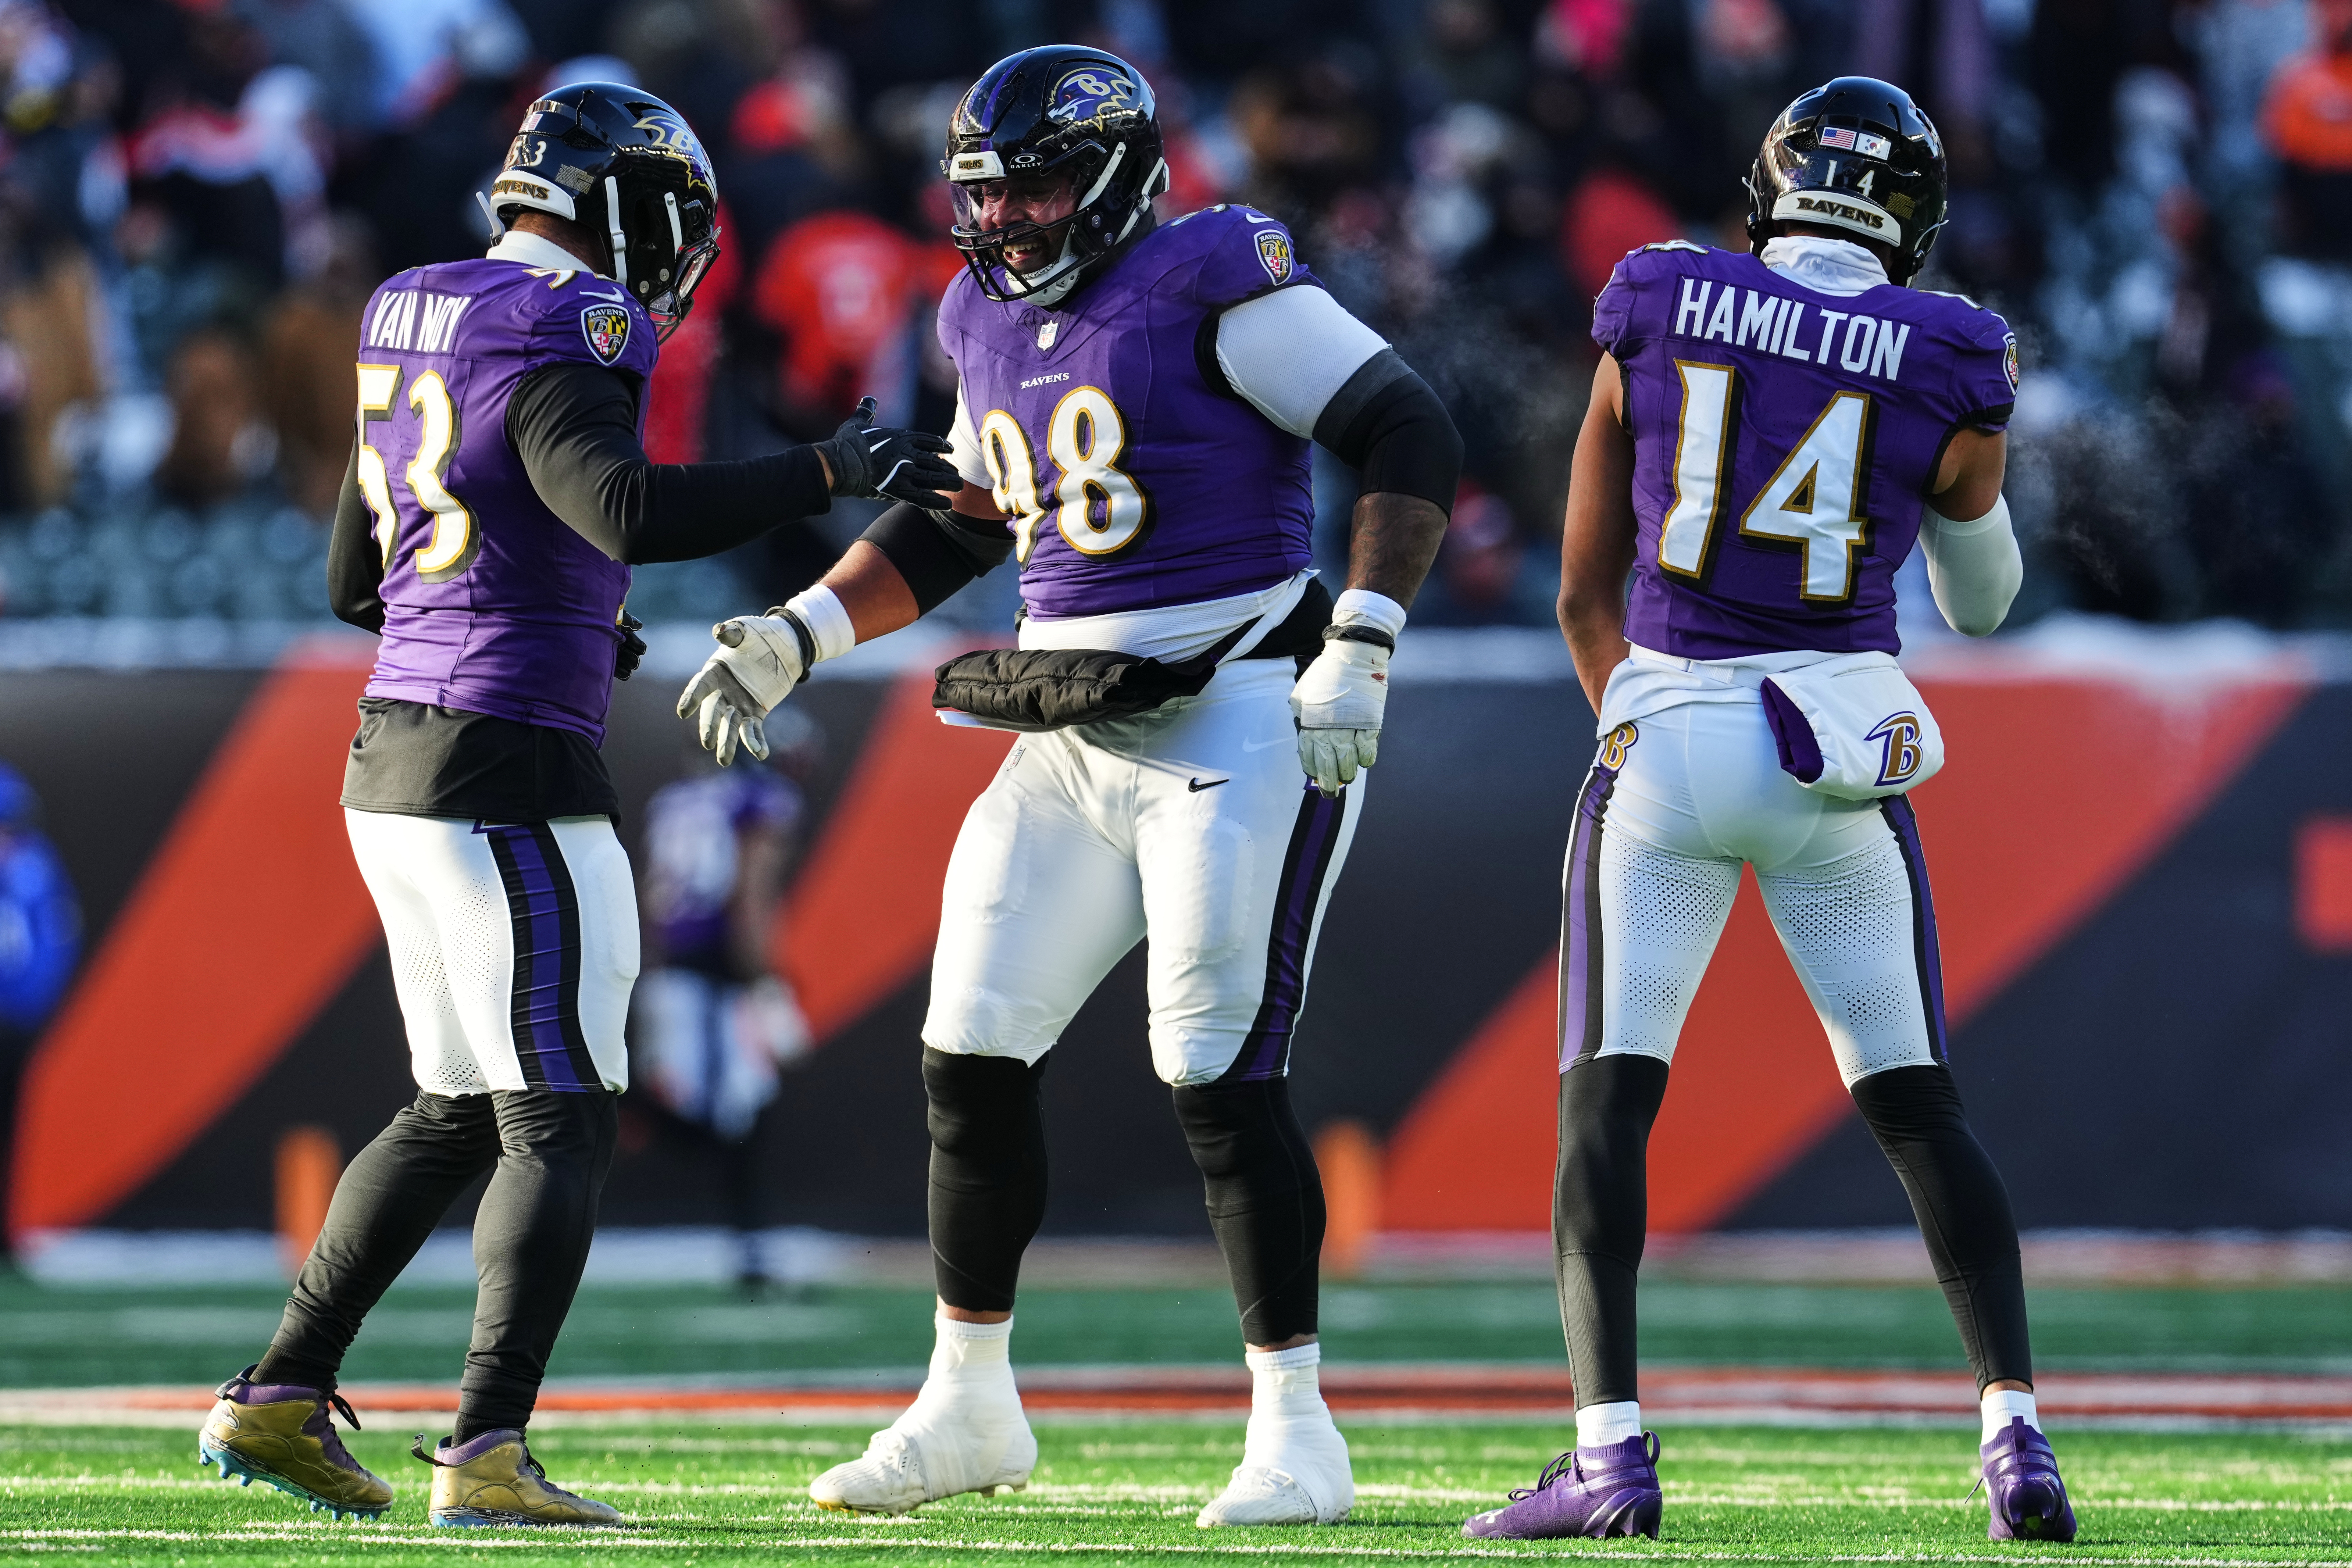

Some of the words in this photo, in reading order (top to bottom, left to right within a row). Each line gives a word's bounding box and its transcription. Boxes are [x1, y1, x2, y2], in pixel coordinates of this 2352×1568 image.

[958, 159, 984, 169] RAVENS
[1825, 160, 1875, 196] 14
[1796, 197, 1884, 229] RAVENS
[1259, 234, 1284, 242] RAVENS
[369, 291, 418, 350] VAN
[416, 293, 471, 352] NOY
[588, 309, 624, 317] RAVENS
[1675, 278, 1910, 381] HAMILTON
[1041, 334, 1052, 344] NFL
[1020, 373, 1070, 389] RAVENS
[356, 362, 481, 584] 53
[980, 385, 1157, 571] 98
[1658, 357, 1880, 611] 14
[1863, 711, 1923, 786] B
